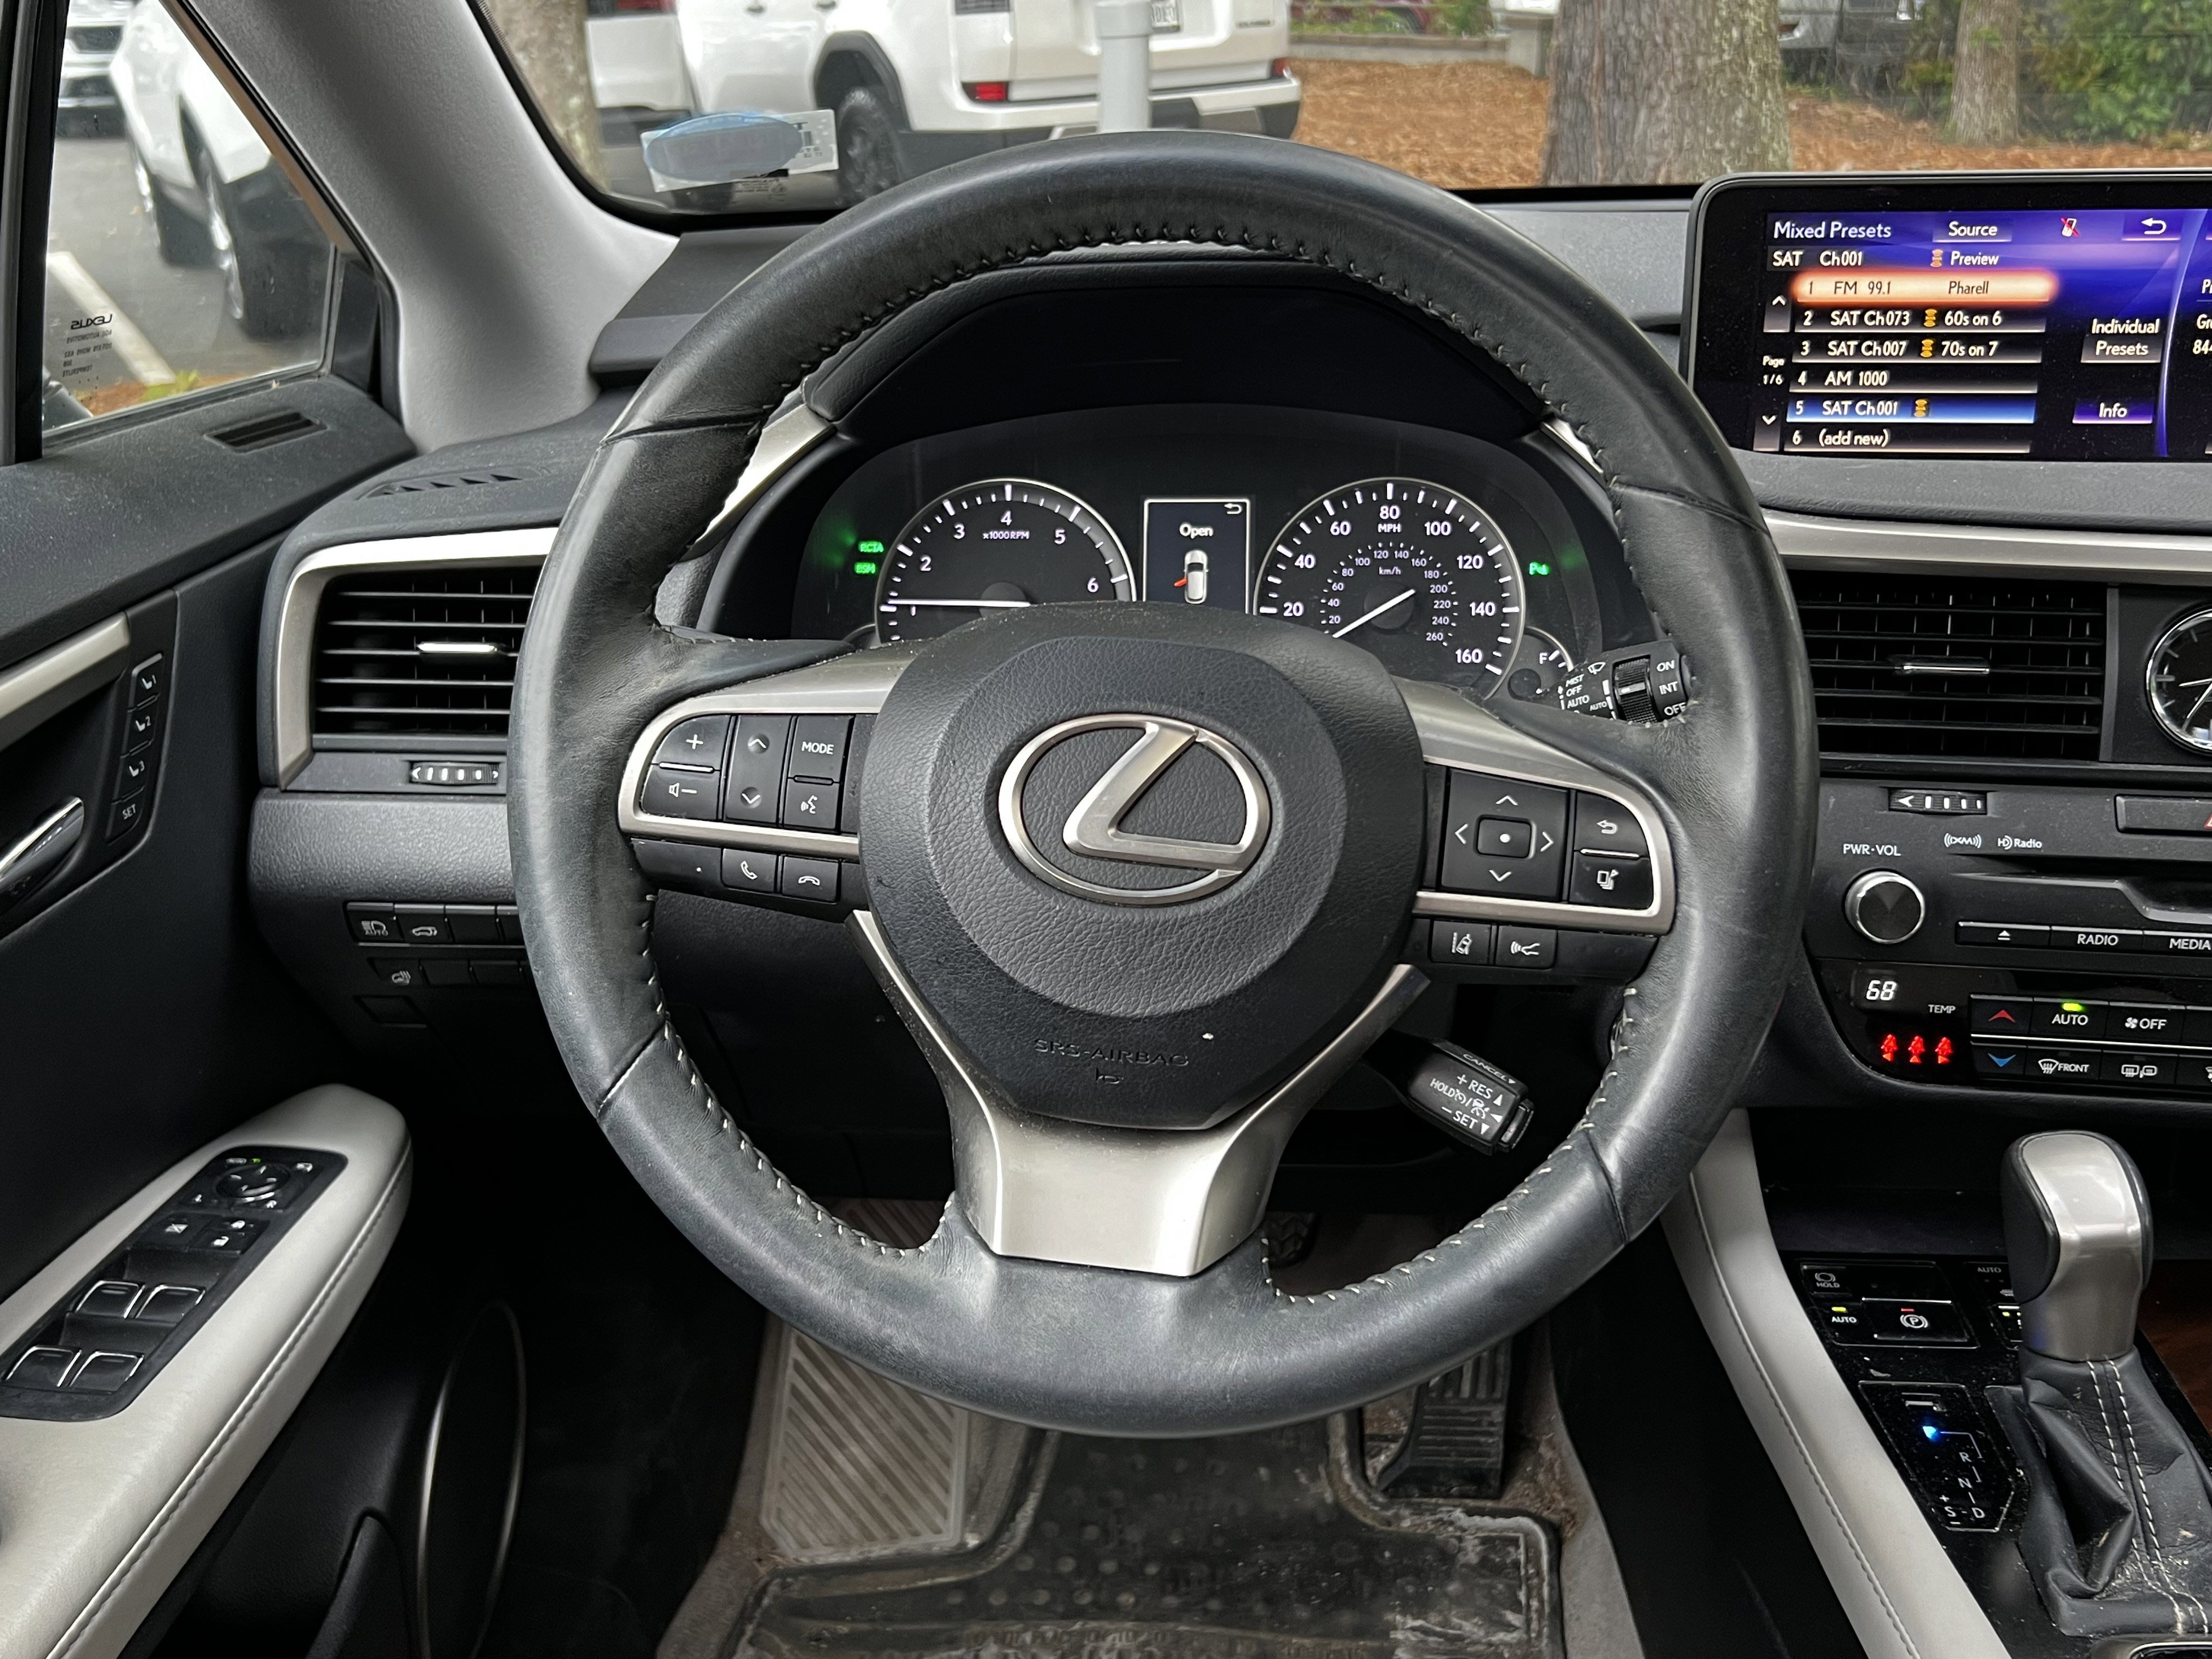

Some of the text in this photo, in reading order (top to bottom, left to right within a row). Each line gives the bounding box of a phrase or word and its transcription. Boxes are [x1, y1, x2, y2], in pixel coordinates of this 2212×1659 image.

[1774, 221, 1892, 238] Mixed Presets
[1949, 221, 1997, 236] Source
[1772, 251, 1803, 266] SAT
[1950, 251, 1999, 266] Preview
[1809, 280, 1989, 295] 1 FM 99.1 Pharell
[1803, 311, 1813, 326] 2
[1830, 311, 1861, 326] SAT
[1944, 311, 1970, 326] 60s
[1972, 315, 1989, 326] on
[1992, 311, 2002, 326] 6
[2091, 318, 2160, 334] Individual
[1801, 341, 1810, 356] 3
[1827, 341, 1859, 356] SAT
[1942, 341, 1965, 356] 70s
[1968, 345, 1985, 356] on
[1989, 341, 1999, 356] 7
[2095, 340, 2149, 356] Presets
[1762, 356, 1785, 368] Page
[1763, 374, 1784, 385] 1/6
[1797, 371, 1888, 386] 4 AM 1000
[1795, 400, 1804, 415] 5
[1822, 400, 1852, 415] SAT
[2098, 403, 2128, 417] Info
[1792, 428, 1889, 447] 6 (add new)
[1001, 510, 1013, 526] 4
[1379, 505, 1401, 520] 80
[953, 523, 966, 539] 3
[1180, 522, 1214, 539] Open
[1329, 521, 1351, 535] 60
[1378, 523, 1402, 534] MPH
[1425, 521, 1452, 536] 100
[1054, 529, 1066, 545] 5
[1373, 550, 1389, 559] 120
[1393, 550, 1409, 559] 140
[920, 556, 932, 572] 2
[1294, 554, 1316, 569] 40
[1355, 557, 1370, 567] 100
[1411, 558, 1427, 567] 160
[1457, 555, 1483, 569] 120
[1342, 568, 1354, 577] 80
[1379, 567, 1401, 575] km/h
[1424, 570, 1440, 579] 180
[1087, 578, 1099, 593] 6
[1331, 582, 1344, 591] 60
[1430, 584, 1448, 593] 200
[1328, 598, 1340, 607] 40
[1434, 600, 1451, 609] 220
[1283, 602, 1304, 617] 20
[1469, 602, 1496, 617] 140
[1329, 615, 1341, 624] 20
[1432, 616, 1449, 625] 240
[1426, 632, 1444, 641] 260
[1455, 649, 1482, 664] 160
[1539, 652, 1548, 664] F
[1656, 660, 1675, 672] ON
[1565, 674, 1584, 687] MIST
[1566, 685, 1583, 697] OFF
[1659, 681, 1679, 695] INT
[1567, 695, 1590, 709] AUTO
[1590, 701, 1607, 712] AUTO
[1663, 702, 1686, 716] OFF
[145, 716, 151, 727] 2
[801, 741, 834, 755] MODE
[139, 761, 145, 772] 3
[121, 804, 137, 820] SET
[2014, 838, 2042, 849] Radio
[2077, 934, 2119, 946] RADIO
[2169, 938, 2211, 950] MEDIA
[1866, 980, 1898, 1001] 68
[1928, 1004, 1956, 1014] TEMP
[2052, 1014, 2088, 1025] AUTO
[2139, 1018, 2167, 1030] OFF
[1463, 1053, 1508, 1082] CANCEL
[2057, 1063, 2089, 1073] FRONT
[1430, 1078, 1455, 1098] HOLD
[1959, 1452, 1972, 1463] R
[1957, 1477, 1972, 1488] N
[1944, 1506, 1985, 1519] S D
